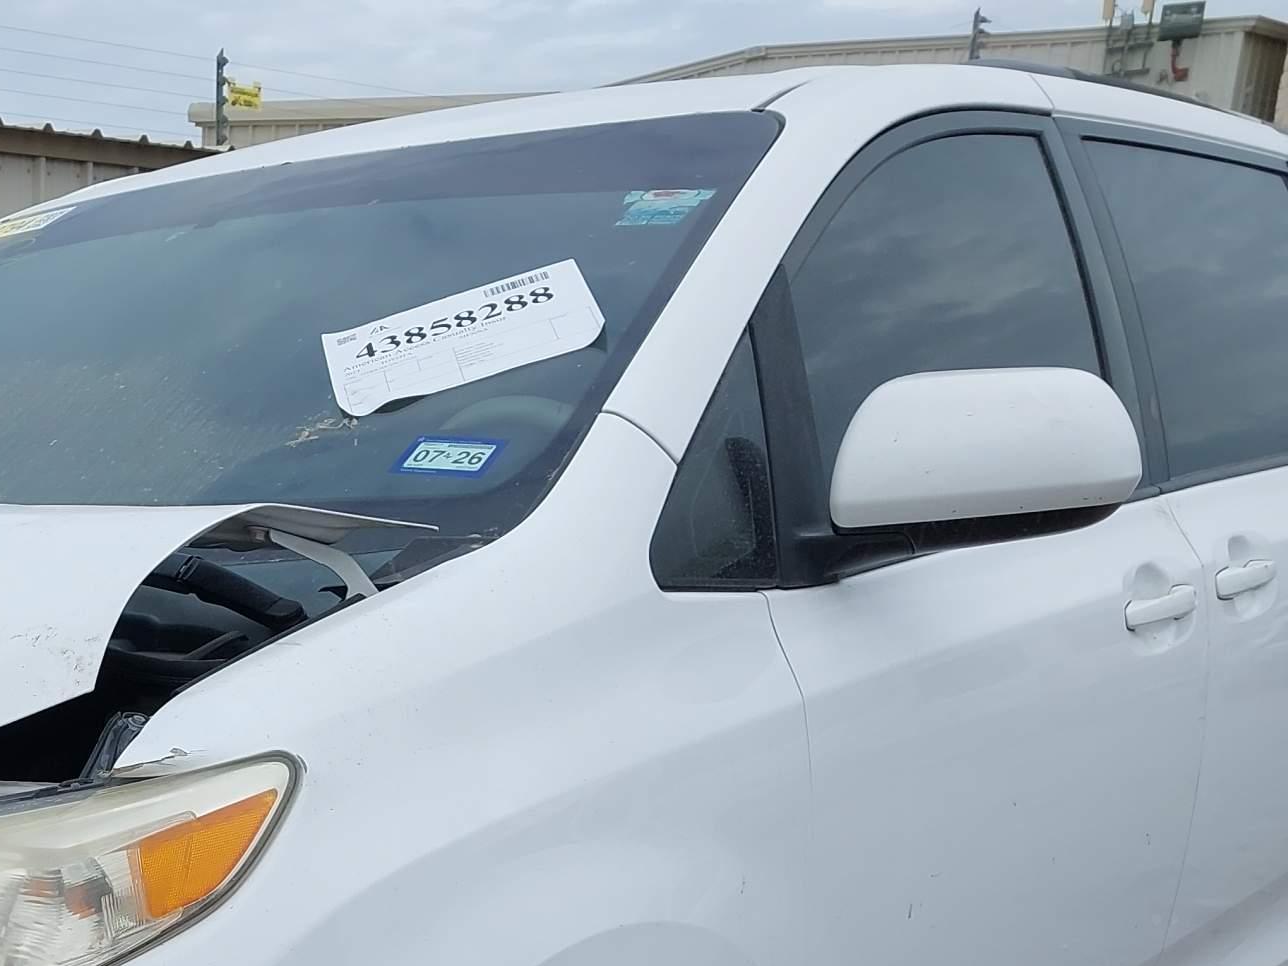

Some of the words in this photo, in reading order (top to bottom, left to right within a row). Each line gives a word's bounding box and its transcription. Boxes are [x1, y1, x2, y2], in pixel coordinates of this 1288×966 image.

[355, 286, 554, 358] 43858288
[413, 449, 446, 463] 07
[451, 451, 486, 465] 26
